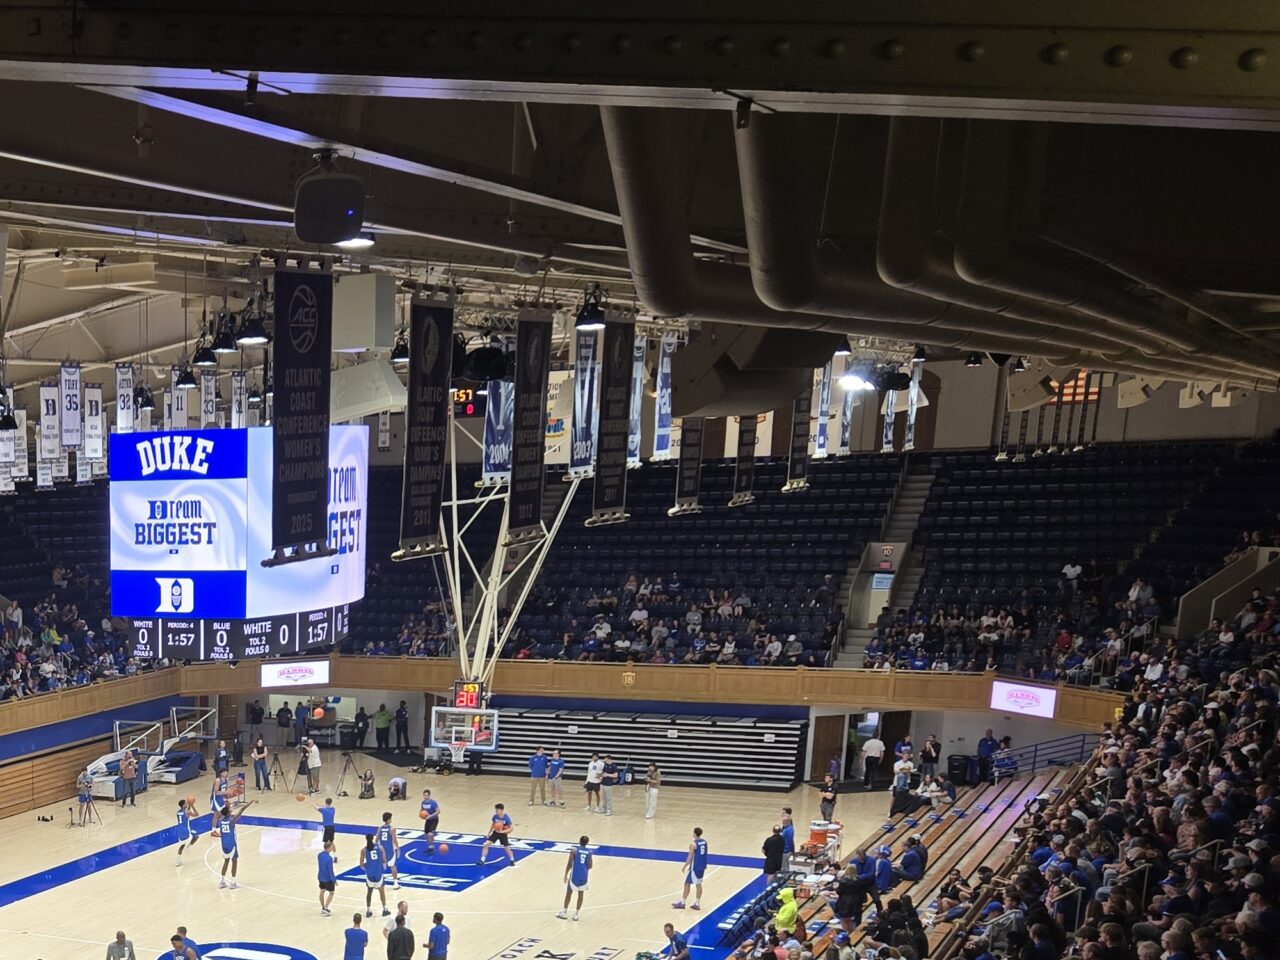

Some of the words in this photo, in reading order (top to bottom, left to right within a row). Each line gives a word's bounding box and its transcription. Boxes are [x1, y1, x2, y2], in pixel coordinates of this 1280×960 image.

[293, 306, 316, 323] ACC
[284, 368, 321, 387] ATLANTIC
[65, 394, 78, 411] 35
[120, 394, 131, 410] 32
[176, 395, 183, 411] 11
[204, 400, 214, 414] 33
[290, 392, 316, 410] COAST
[276, 414, 328, 434] CONFERENCE
[284, 437, 320, 458] WOMEN'S
[136, 435, 214, 476] DUKE
[290, 513, 313, 534] 2025
[135, 522, 217, 545] BIGGEST
[133, 620, 153, 628] WHITE
[213, 622, 231, 630] BLUE
[243, 621, 272, 635] WHITE
[138, 629, 148, 644] 0
[167, 633, 195, 646] 1:57
[217, 631, 227, 646] 0
[249, 638, 261, 646] TOL
[262, 636, 266, 645] 2
[279, 624, 289, 645] 0
[307, 623, 329, 644] 1:57
[245, 646, 264, 656] FOULS
[265, 645, 270, 653] 0
[624, 676, 634, 685] 18
[456, 692, 478, 707] 30
[221, 824, 230, 834] 21
[381, 832, 388, 841] 2
[370, 850, 378, 860] 6
[580, 854, 586, 864] 5
